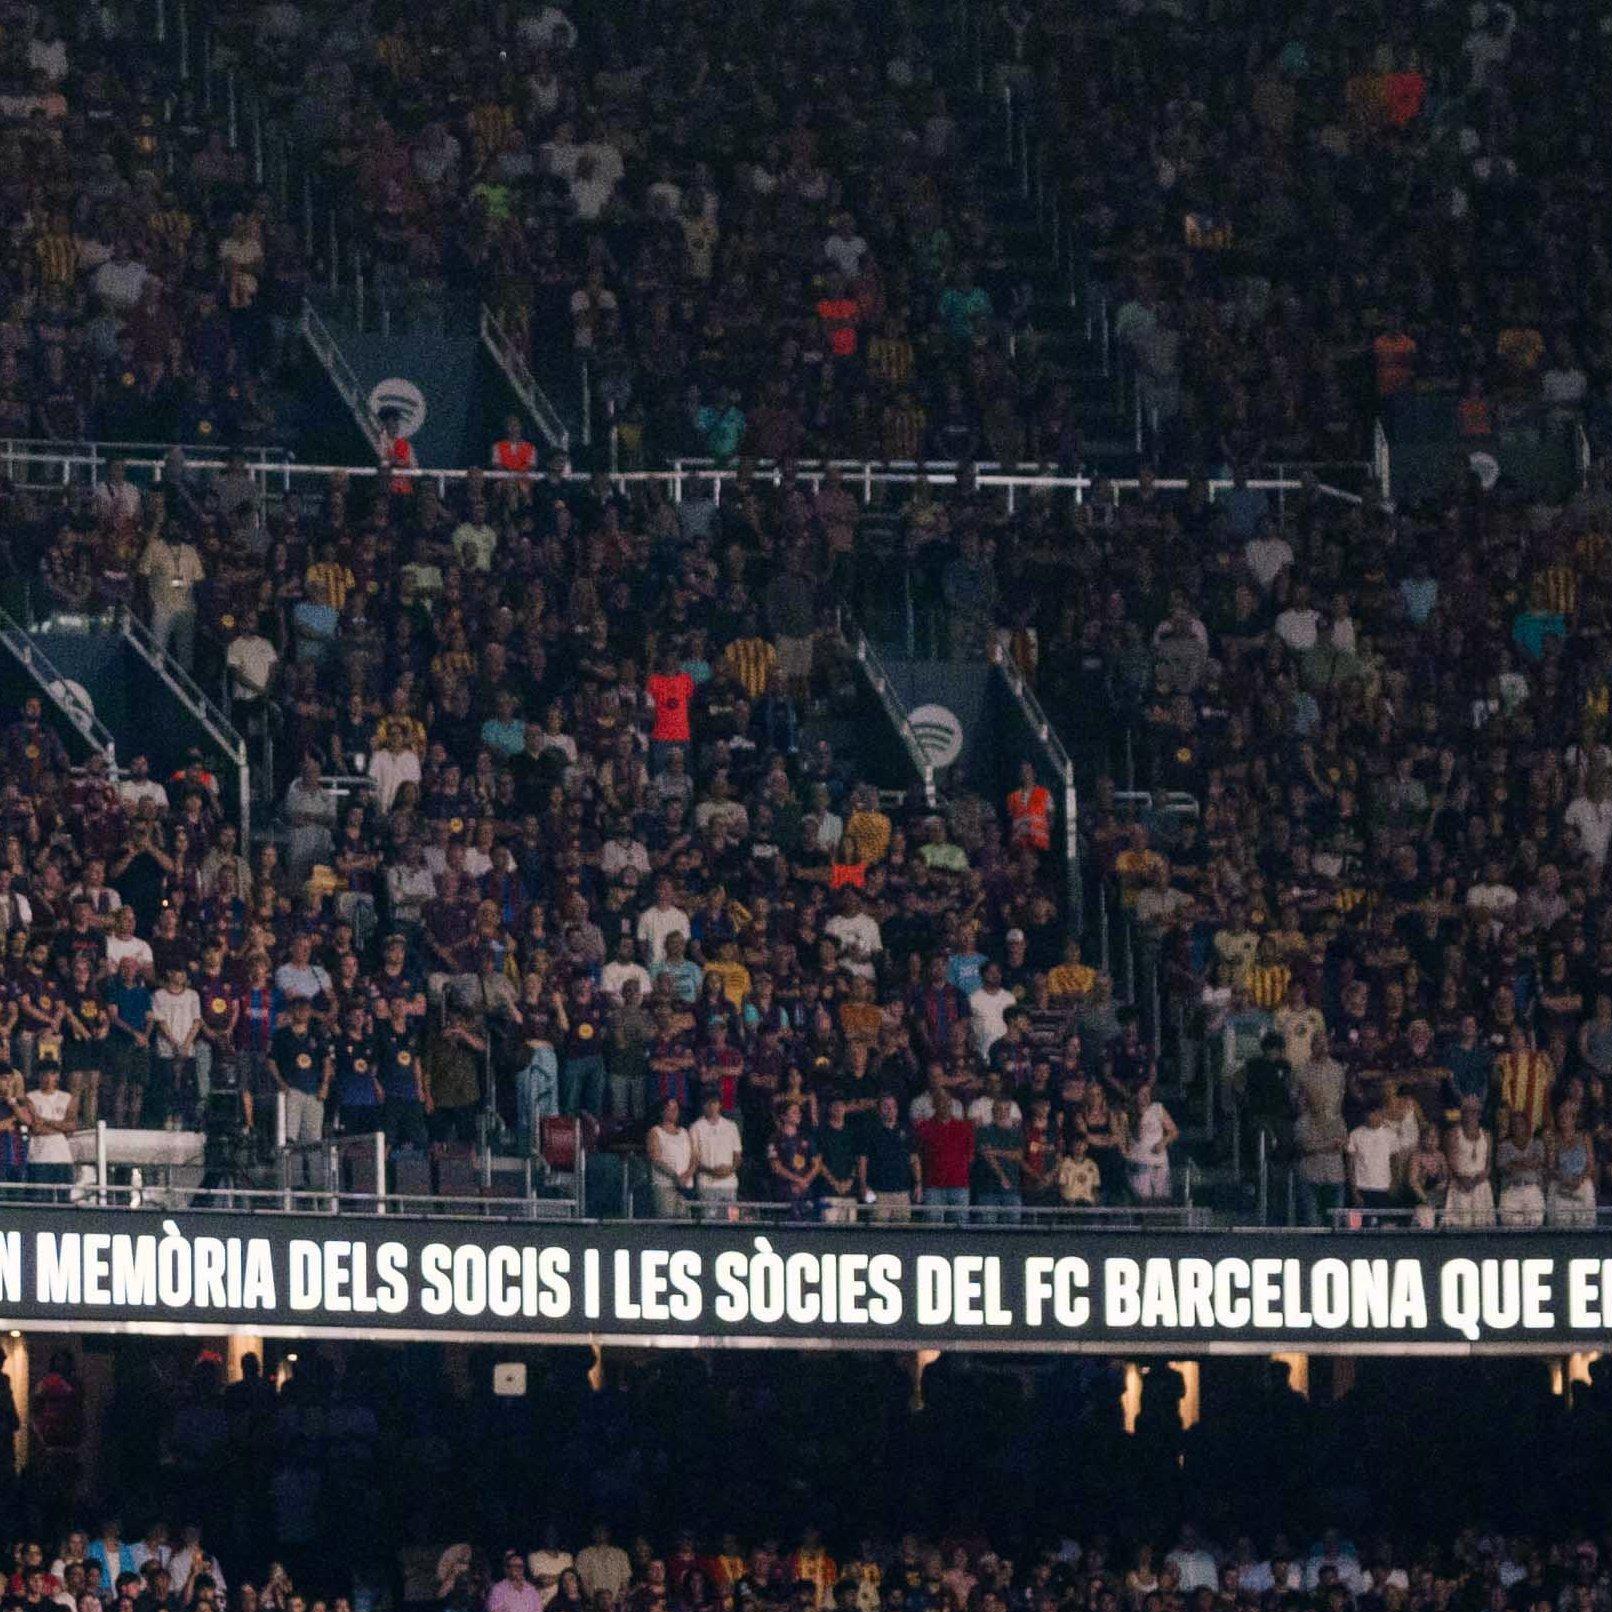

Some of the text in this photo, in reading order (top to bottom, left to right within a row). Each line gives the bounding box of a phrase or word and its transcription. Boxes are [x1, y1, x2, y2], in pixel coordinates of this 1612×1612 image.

[36, 1219, 277, 1310] MEMÒRIA
[289, 1239, 409, 1314] DELS
[420, 1242, 572, 1319] SOCIS
[583, 1248, 600, 1319] I
[613, 1248, 703, 1322] LES
[714, 1236, 903, 1325] SÒCIES
[916, 1254, 1013, 1326] DEL
[1024, 1256, 1091, 1328] FC
[1104, 1257, 1428, 1329] BARCELONA
[1440, 1257, 1555, 1341] QUE
